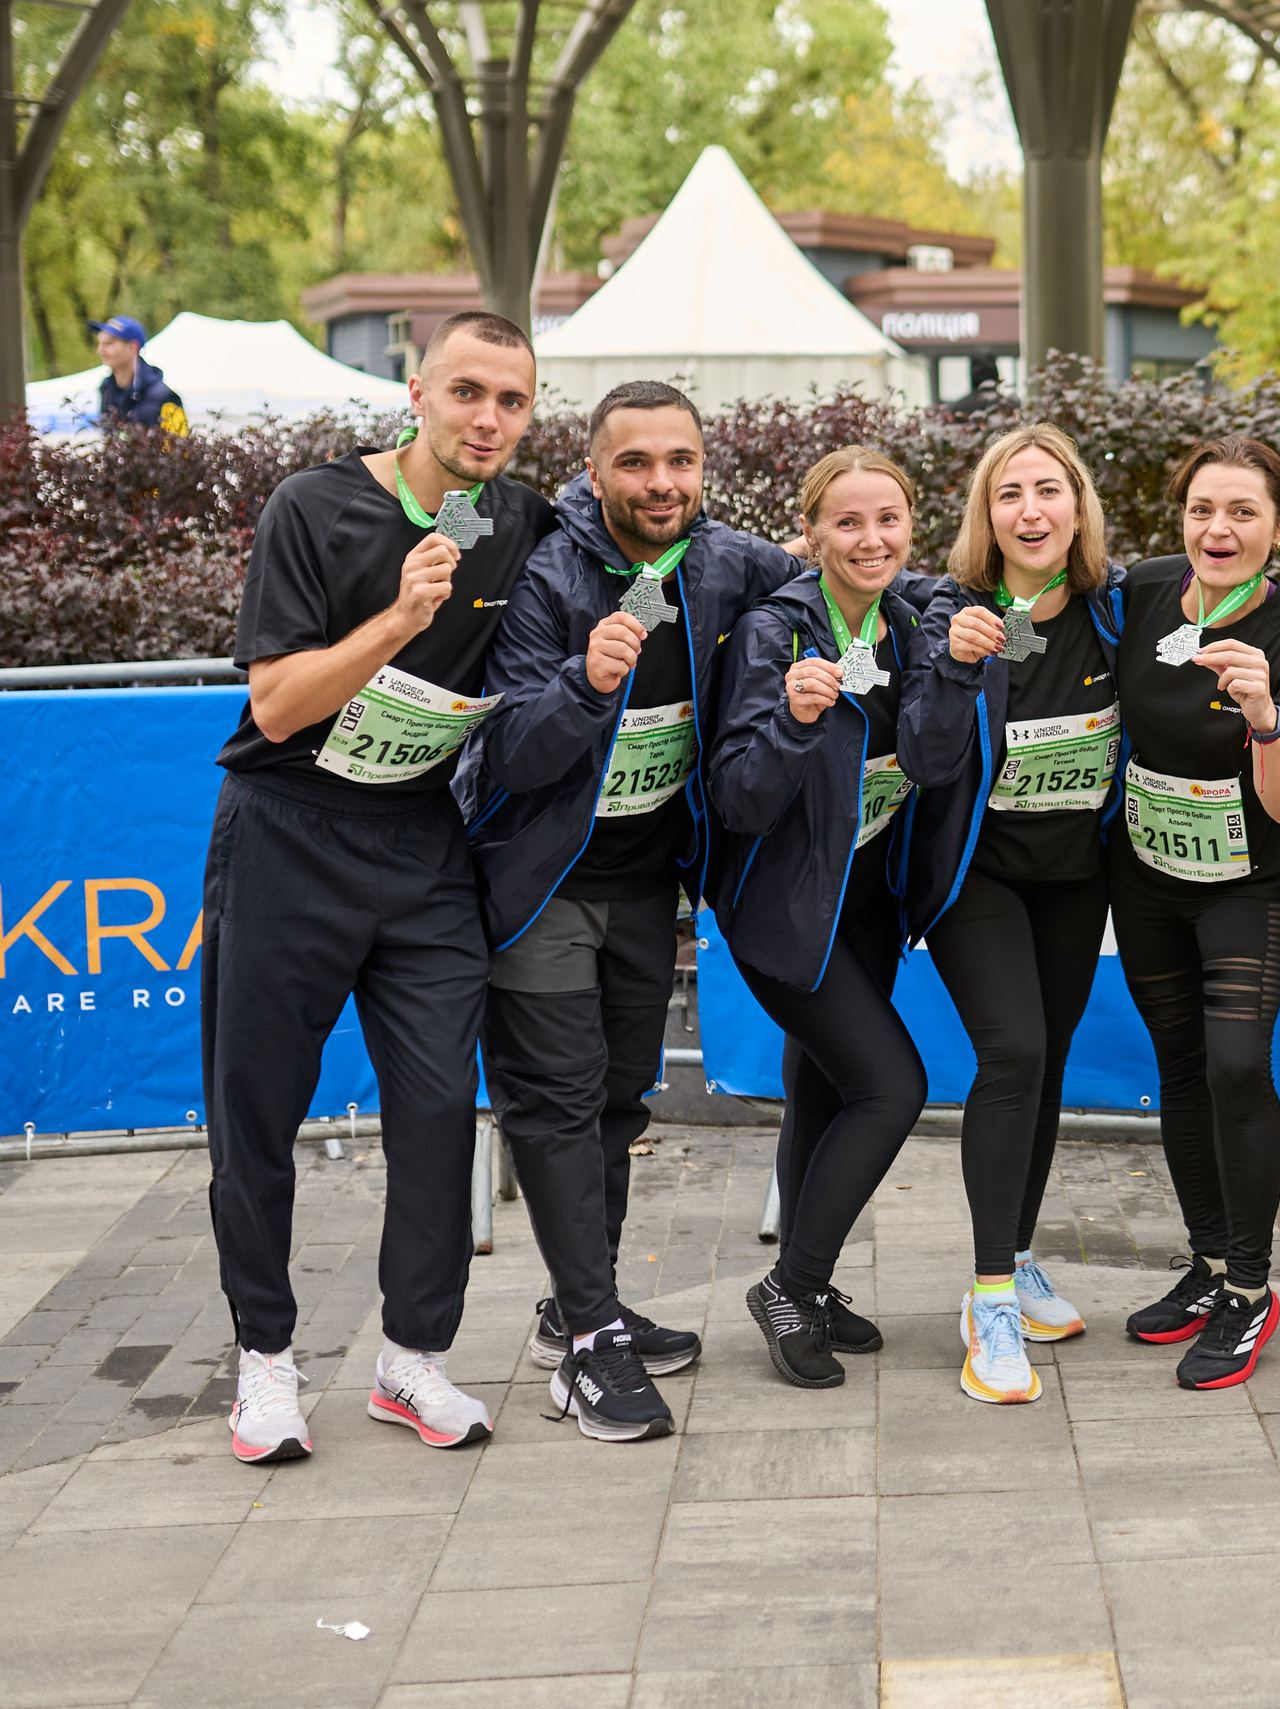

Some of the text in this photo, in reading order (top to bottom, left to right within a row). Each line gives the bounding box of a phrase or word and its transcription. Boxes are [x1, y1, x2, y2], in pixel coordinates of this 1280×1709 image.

[388, 684, 431, 704] ARMOUR
[390, 678, 424, 695] UNDER
[381, 711, 405, 723] Смарт
[406, 719, 434, 729] Простір
[632, 714, 660, 722] UNDER
[1087, 714, 1116, 729] АВРОРА
[402, 730, 429, 738] Андрій
[1034, 725, 1062, 734] UNDER
[1034, 729, 1069, 739] ARMOUR
[349, 734, 447, 766] 21506
[1055, 750, 1078, 758] Простір
[607, 758, 683, 797] 21523
[1014, 768, 1098, 797] 21525
[1142, 775, 1167, 786] UNDER
[1192, 787, 1231, 796] АВРОРА
[1027, 800, 1090, 809] ПриватБанк
[1148, 803, 1212, 820] Смарт Простір GoRun
[1169, 818, 1193, 827] Альона
[1143, 826, 1220, 862] 21511
[1164, 862, 1224, 878] ПриватБанк
[12, 991, 96, 1014] ARE
[612, 1334, 632, 1344] HOKA
[575, 1370, 604, 1407] HOKA
